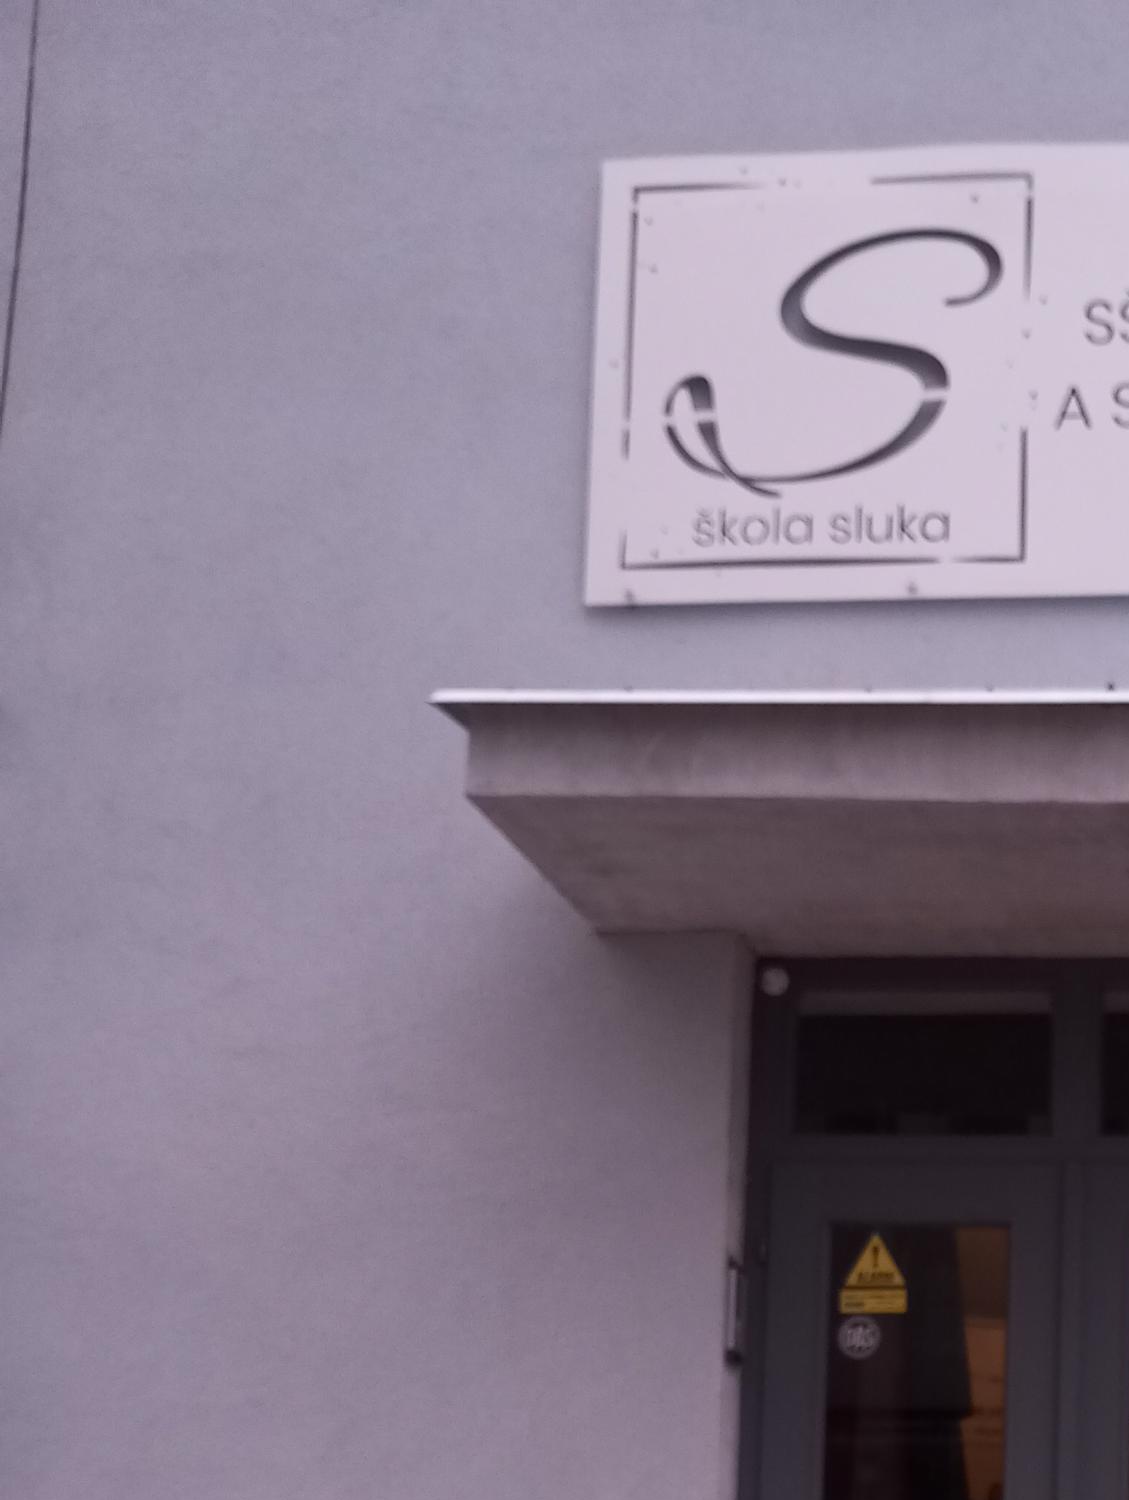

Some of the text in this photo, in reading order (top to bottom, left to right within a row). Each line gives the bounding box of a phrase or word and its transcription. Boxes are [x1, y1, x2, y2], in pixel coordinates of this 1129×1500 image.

[1055, 385, 1093, 431] A
[693, 505, 951, 546] škola sluka
